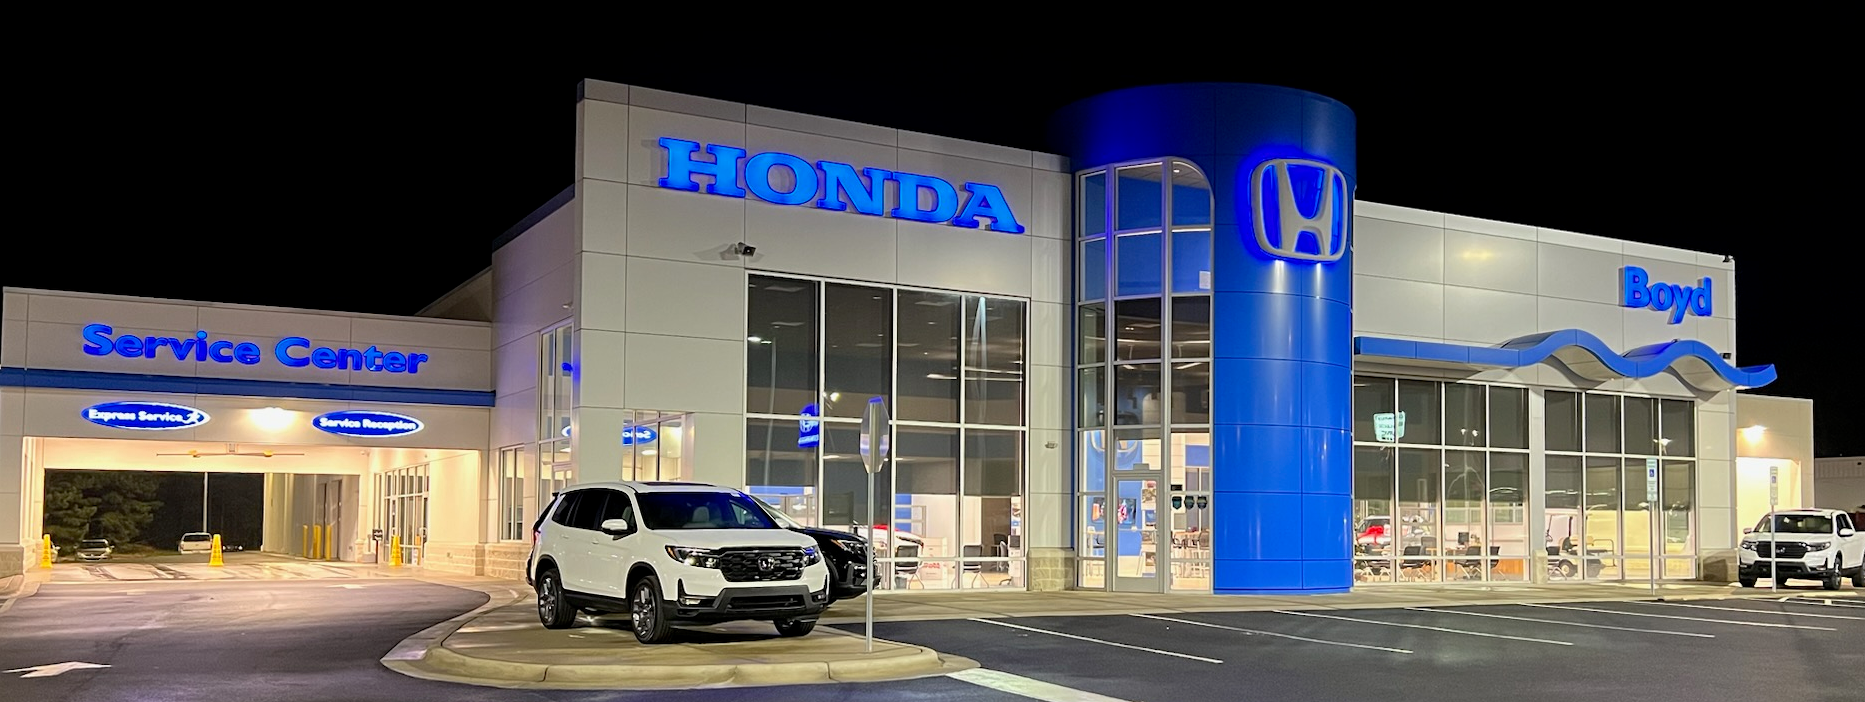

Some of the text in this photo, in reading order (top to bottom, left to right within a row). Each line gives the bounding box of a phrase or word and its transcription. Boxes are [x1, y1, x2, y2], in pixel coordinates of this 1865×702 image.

[658, 136, 1026, 234] HONDA
[1624, 265, 1713, 325] Boyd
[83, 323, 428, 373] Service Center
[88, 408, 184, 422] Express Service
[319, 417, 417, 432] Service Reception
